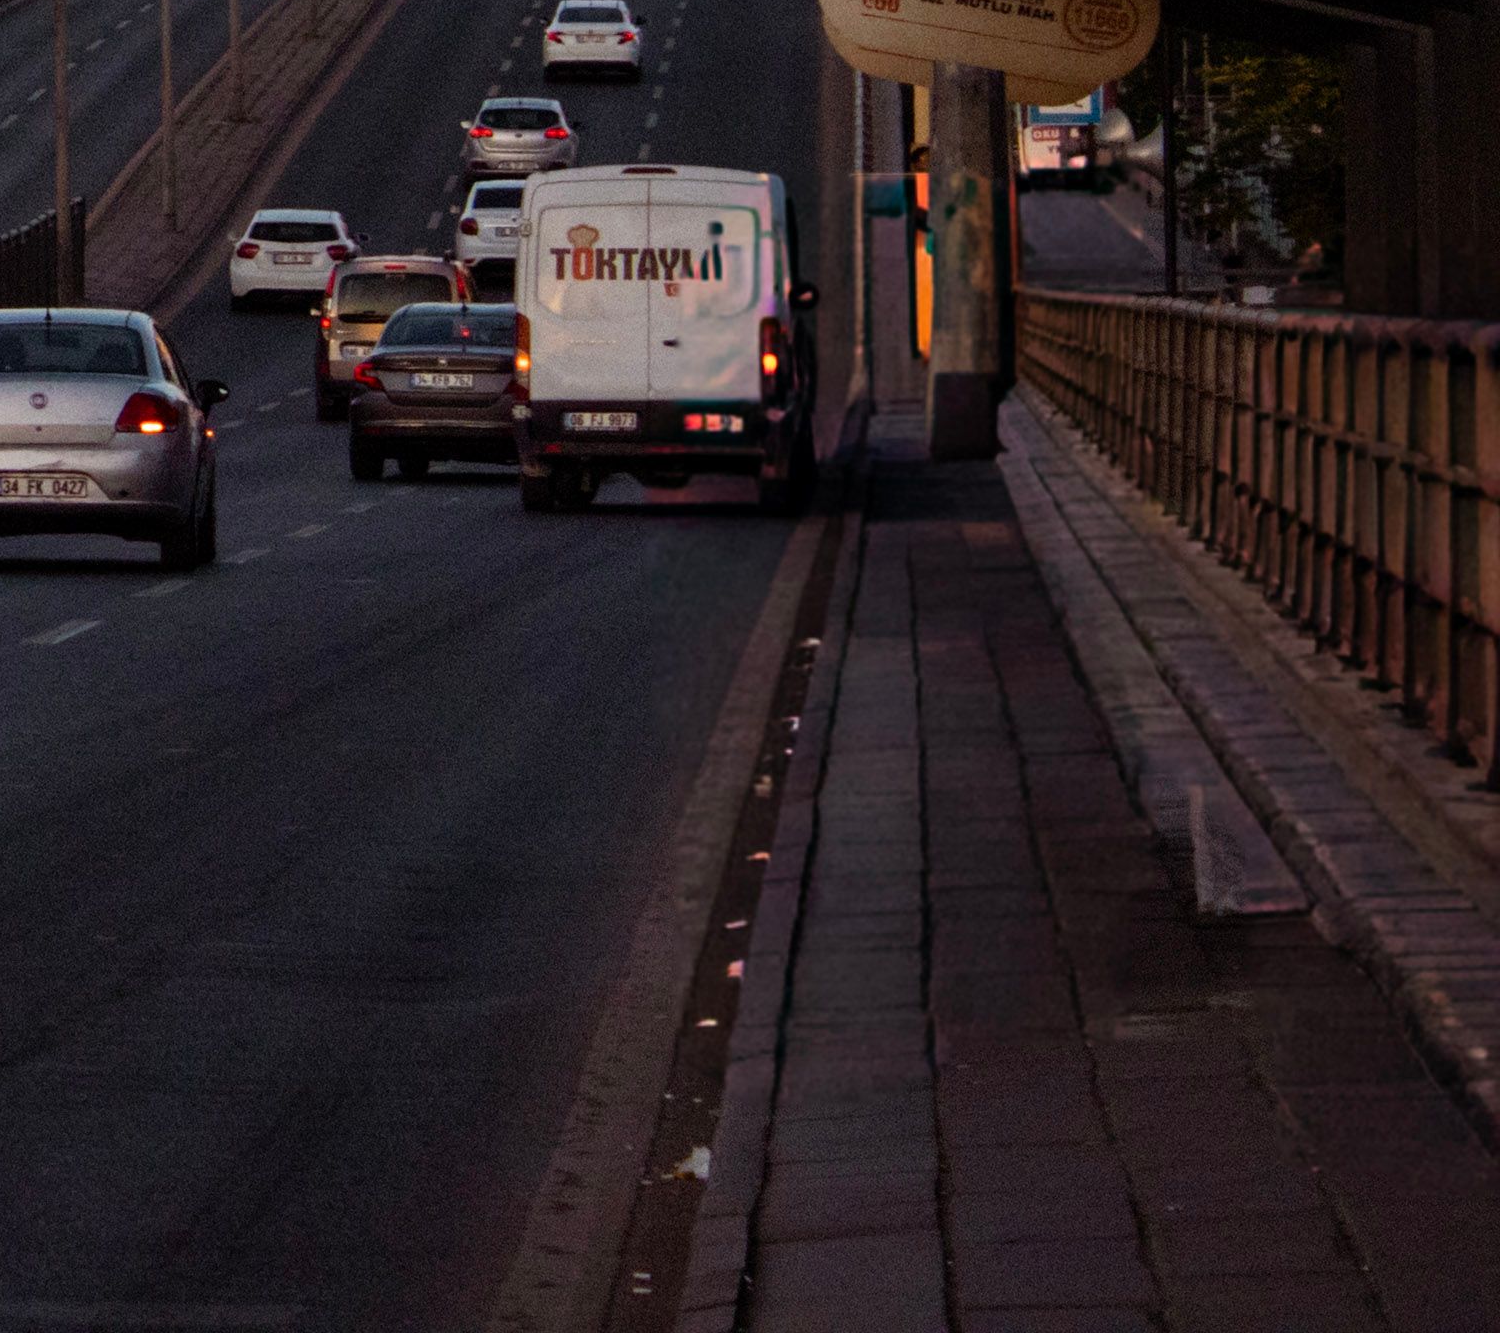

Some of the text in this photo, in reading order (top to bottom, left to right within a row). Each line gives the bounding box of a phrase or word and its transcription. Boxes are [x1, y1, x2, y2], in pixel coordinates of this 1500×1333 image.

[2, 479, 86, 495] 34 FK 0427
